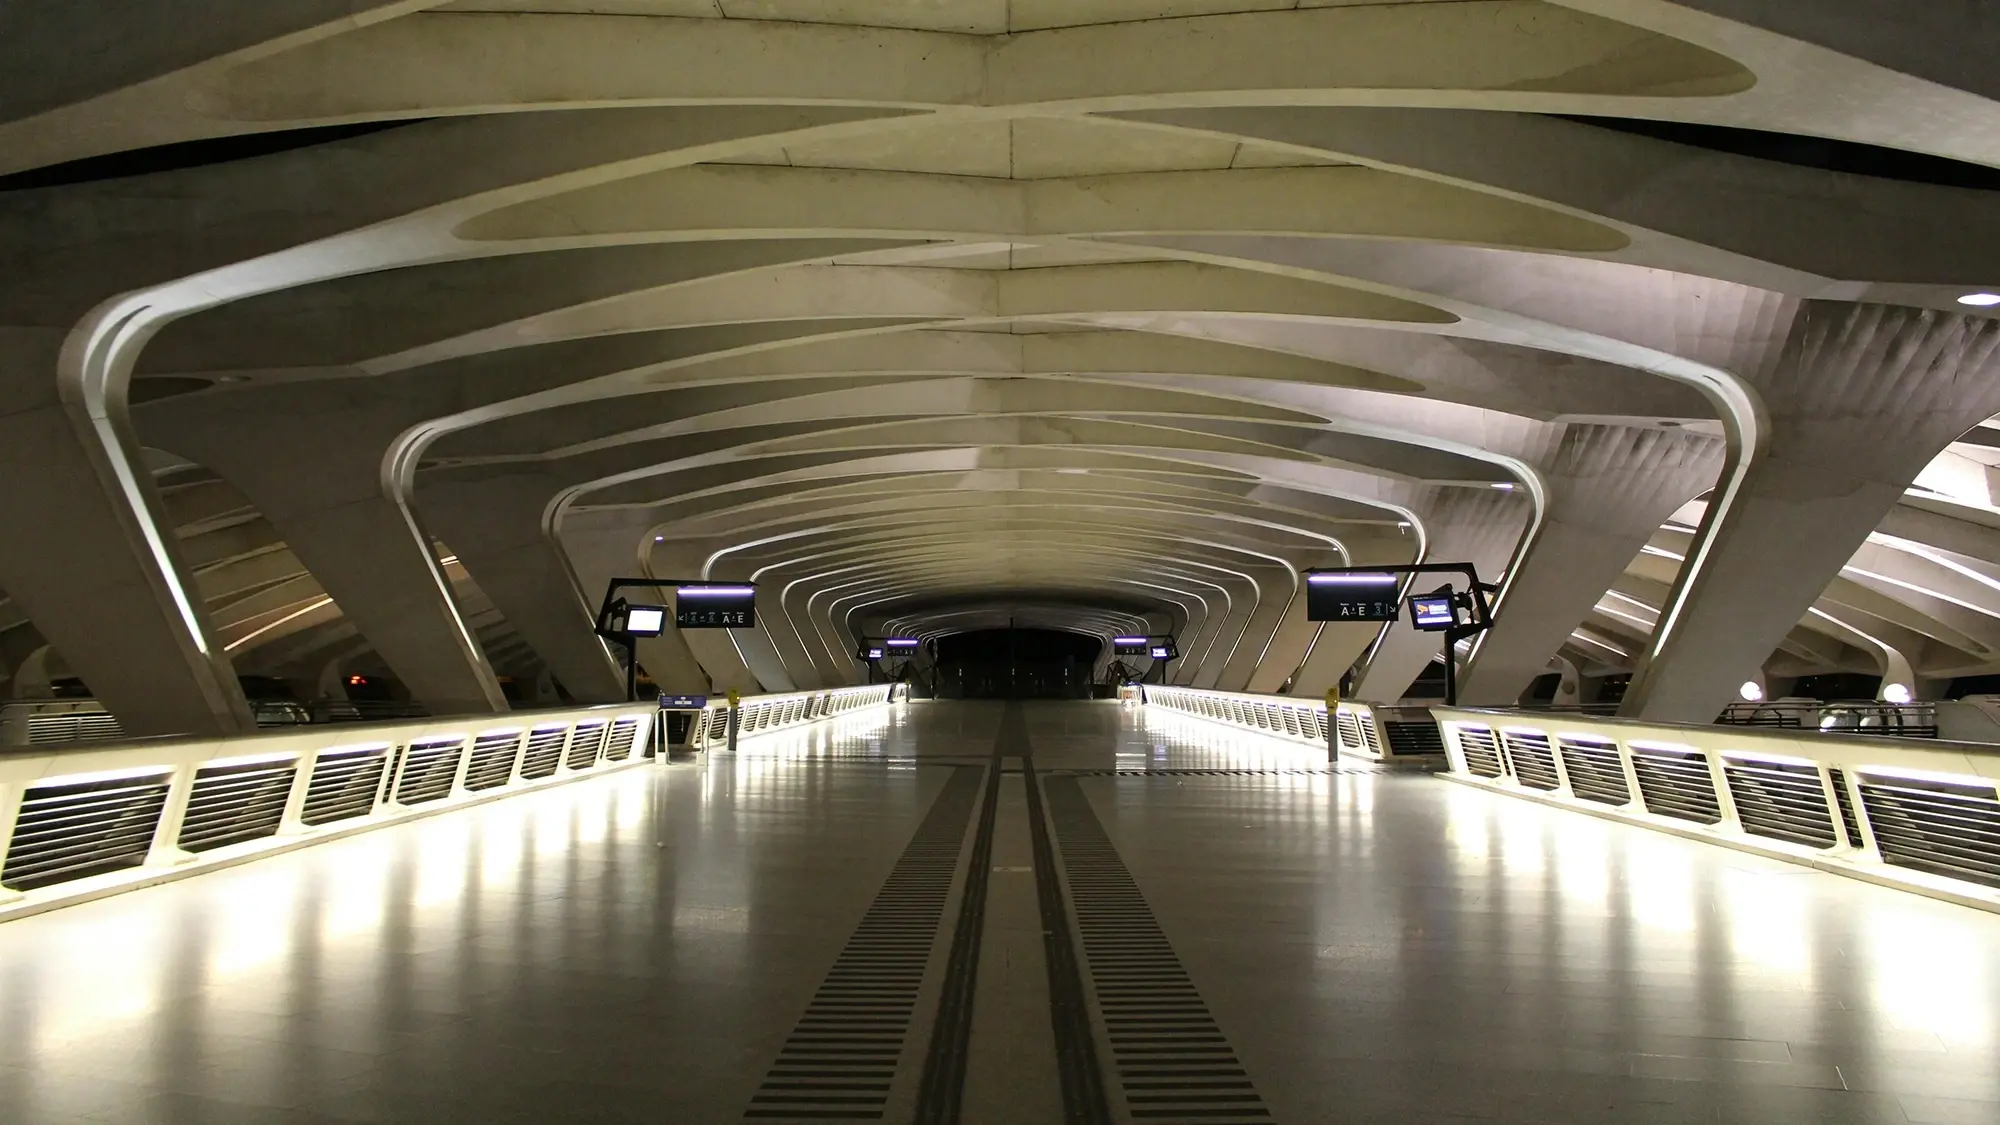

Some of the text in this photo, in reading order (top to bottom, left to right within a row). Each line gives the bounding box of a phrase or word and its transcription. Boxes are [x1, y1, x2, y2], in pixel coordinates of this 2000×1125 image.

[1341, 607, 1349, 615] A
[1358, 607, 1365, 615] E
[722, 615, 730, 623] A
[737, 615, 744, 623] E
